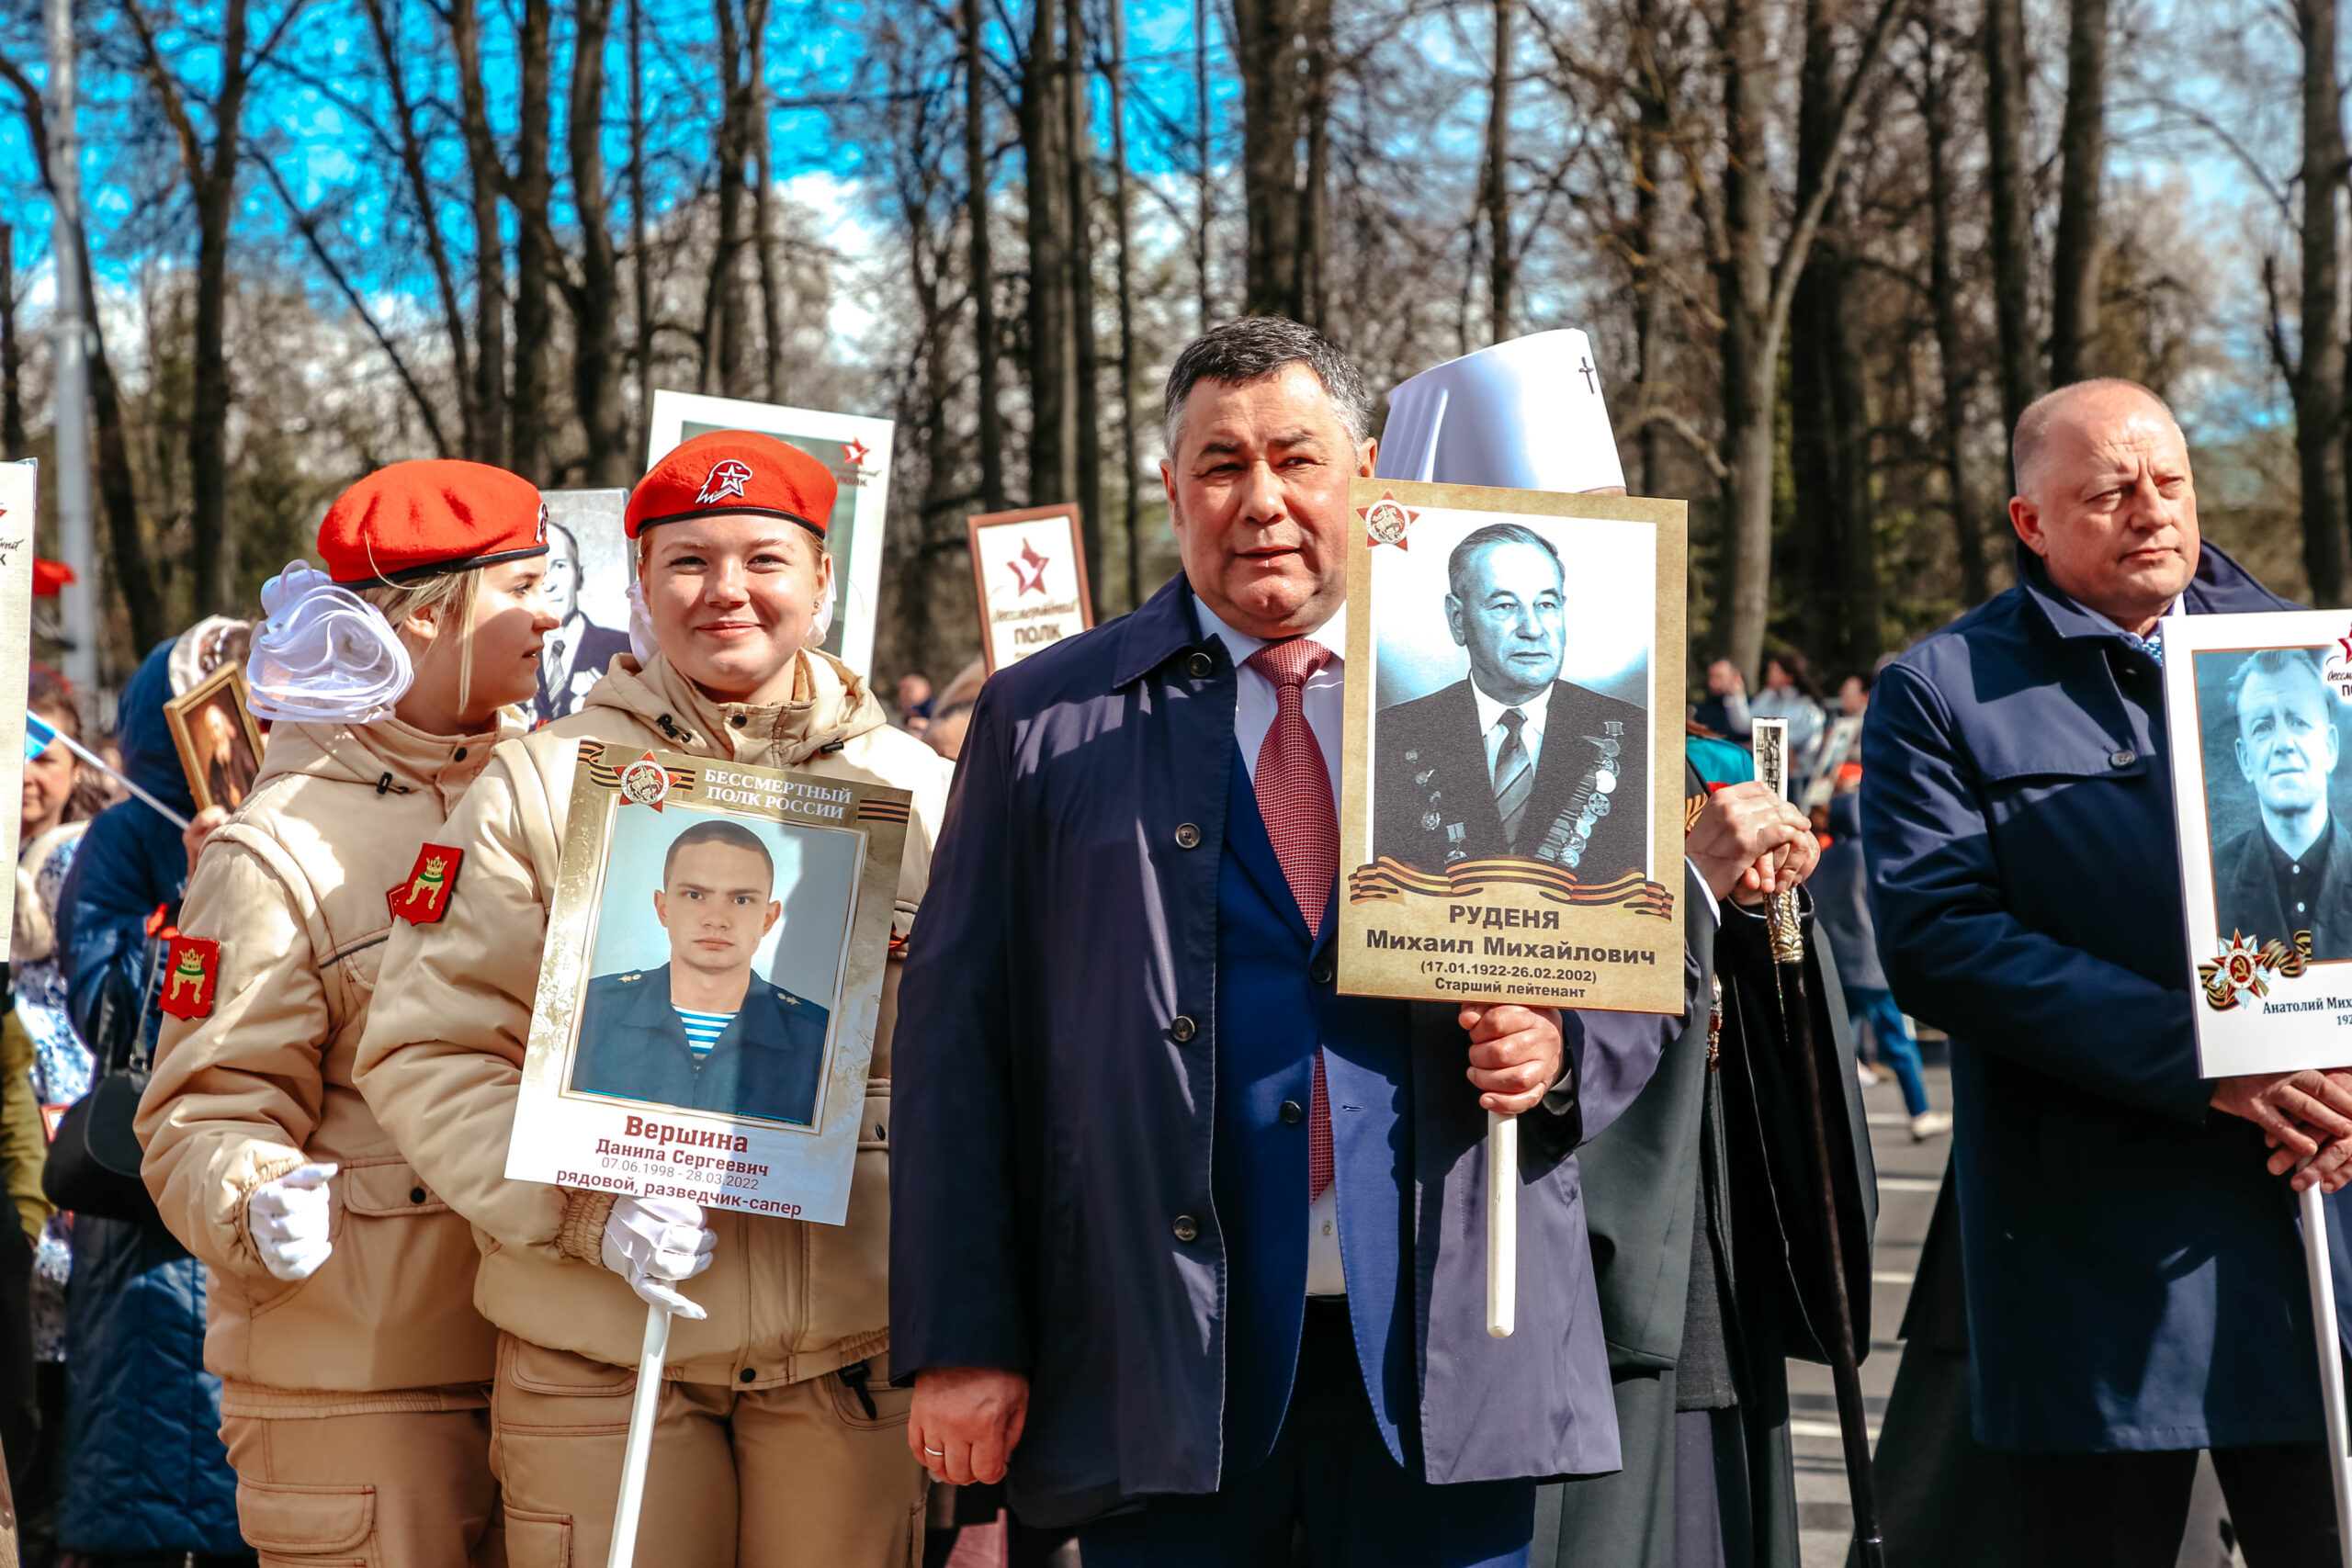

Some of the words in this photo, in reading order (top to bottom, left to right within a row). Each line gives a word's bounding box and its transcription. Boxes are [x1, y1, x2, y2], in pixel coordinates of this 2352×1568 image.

[1014, 624, 1062, 645] ПОЛК
[704, 769, 853, 804] БЕССМЕРТНЫЙ
[707, 785, 762, 807] ПОЛК
[764, 795, 844, 819] РОССИИ
[1449, 905, 1560, 930] РУДЕНЯ
[1366, 929, 1474, 954] Михаил
[1483, 936, 1656, 965] Михайлович
[1420, 961, 1597, 984] (17.01.1922-26.02.2002)
[1435, 976, 1502, 993] Старший
[1506, 982, 1586, 998] лейтенант
[2263, 998, 2324, 1014] Анатолий
[2326, 997, 2352, 1010] Мих
[625, 1115, 749, 1154] Вершина
[595, 1138, 666, 1162] Данила
[673, 1149, 769, 1178] Сергеевич
[601, 1156, 674, 1178] 07.06.1998
[685, 1168, 759, 1190] 28.03.2022
[556, 1168, 639, 1194] рядовой,
[644, 1180, 802, 1219] разведчик-сапер
